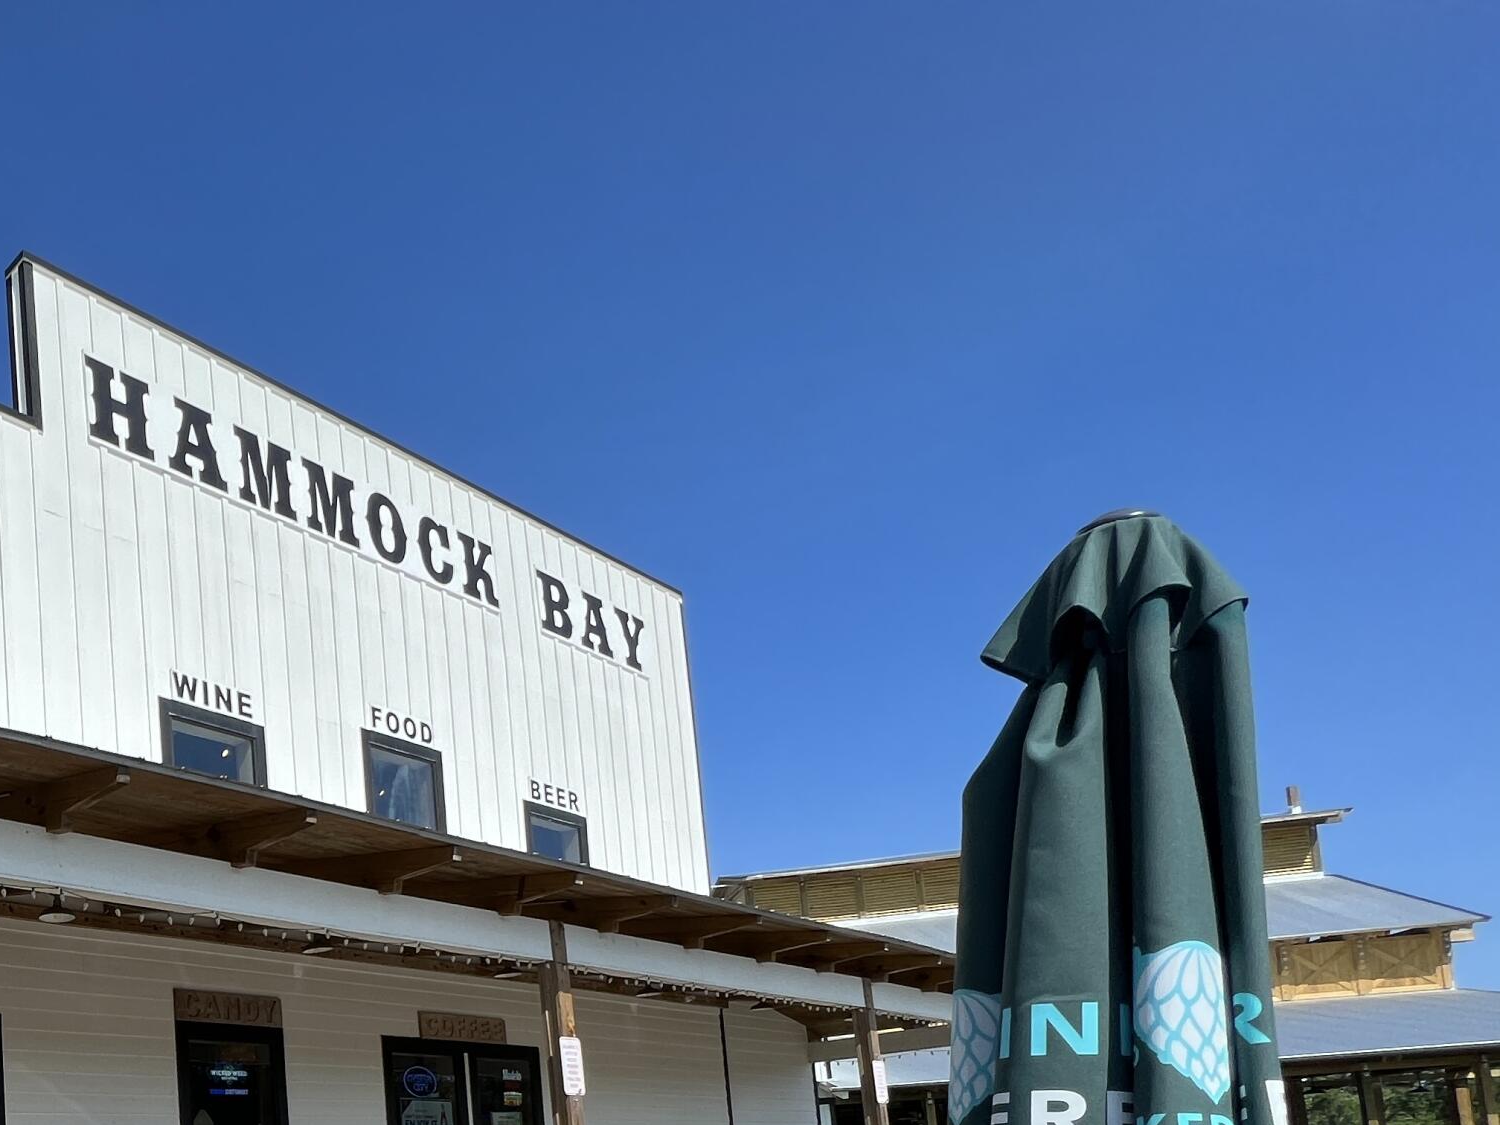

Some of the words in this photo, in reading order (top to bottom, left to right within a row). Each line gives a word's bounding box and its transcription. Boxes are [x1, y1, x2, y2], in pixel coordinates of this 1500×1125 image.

[84, 354, 500, 608] HAMMOCK
[535, 569, 645, 672] BAY
[172, 671, 253, 718] WINE
[370, 705, 433, 744] FOOD
[530, 779, 580, 812] BEER
[186, 993, 277, 1024] CANDY
[425, 1018, 503, 1041] COFFEE
